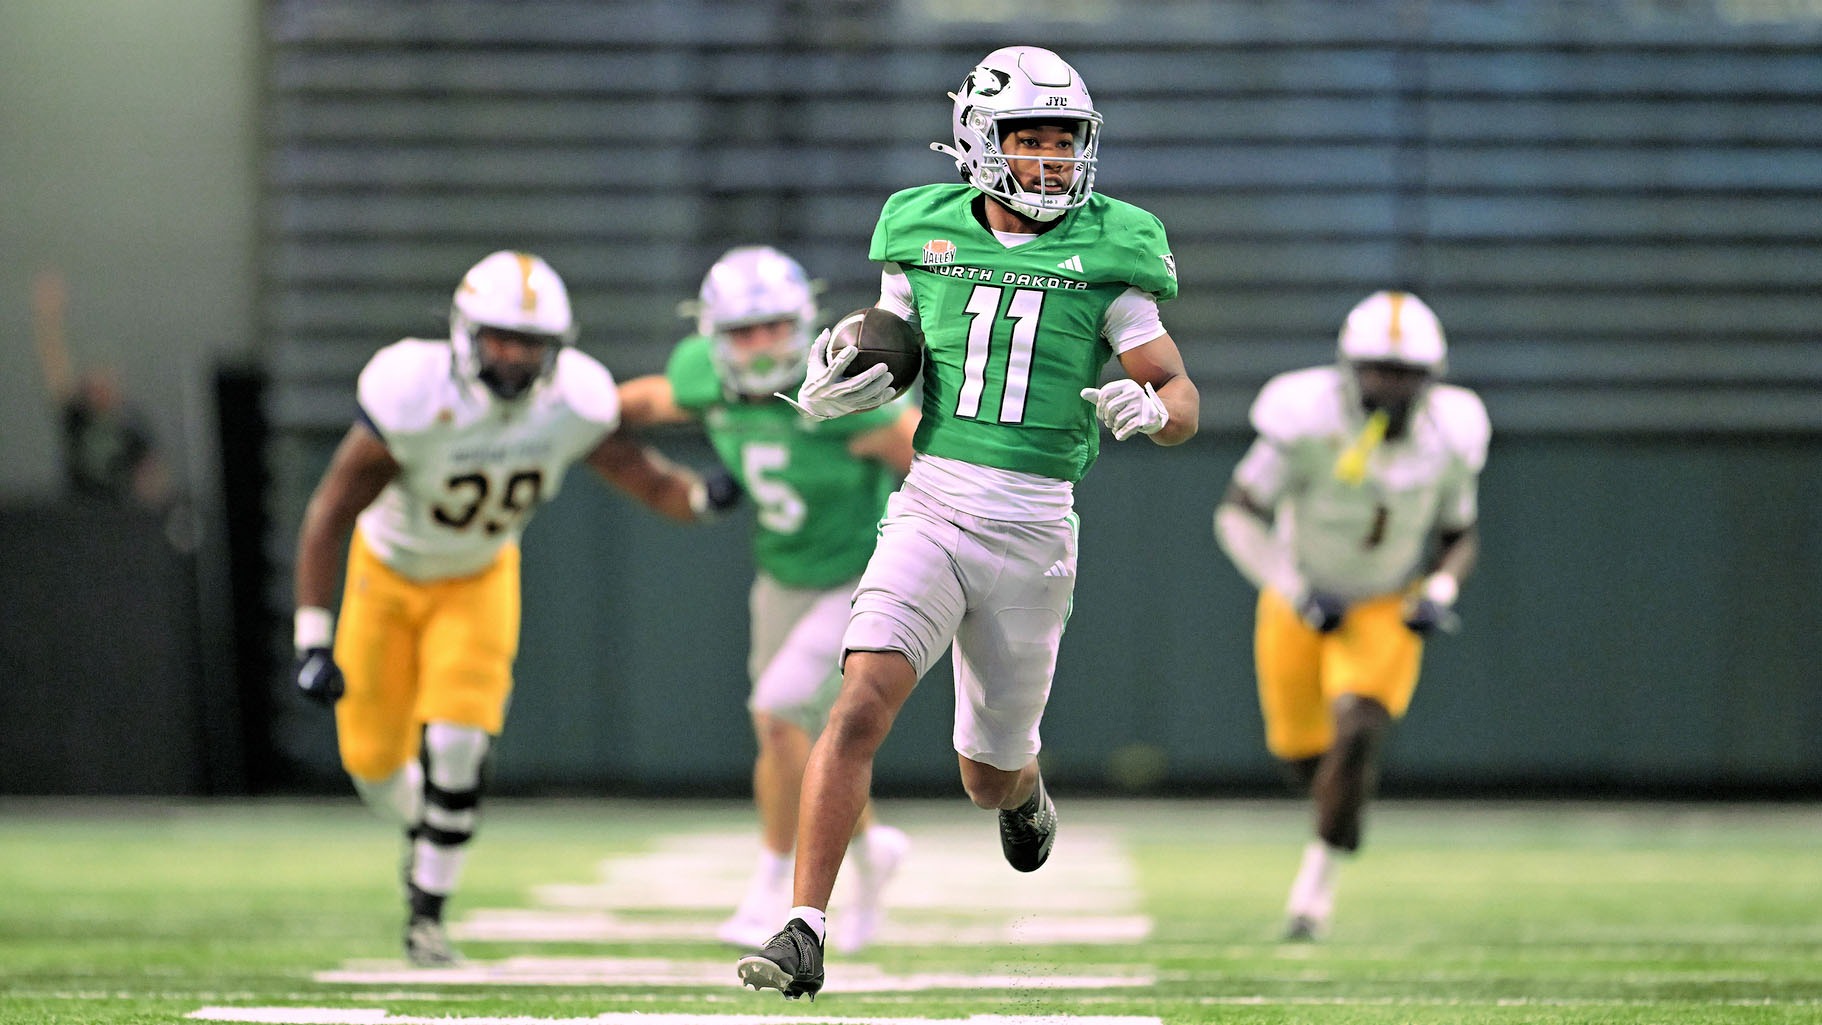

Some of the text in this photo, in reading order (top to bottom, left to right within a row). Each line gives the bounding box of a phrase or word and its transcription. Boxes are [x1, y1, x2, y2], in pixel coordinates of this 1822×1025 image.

[923, 248, 956, 264] VALLEY
[1002, 272, 1088, 290] DAKOTA
[954, 284, 1045, 424] 11
[432, 468, 543, 537] 39
[741, 443, 807, 534] 5
